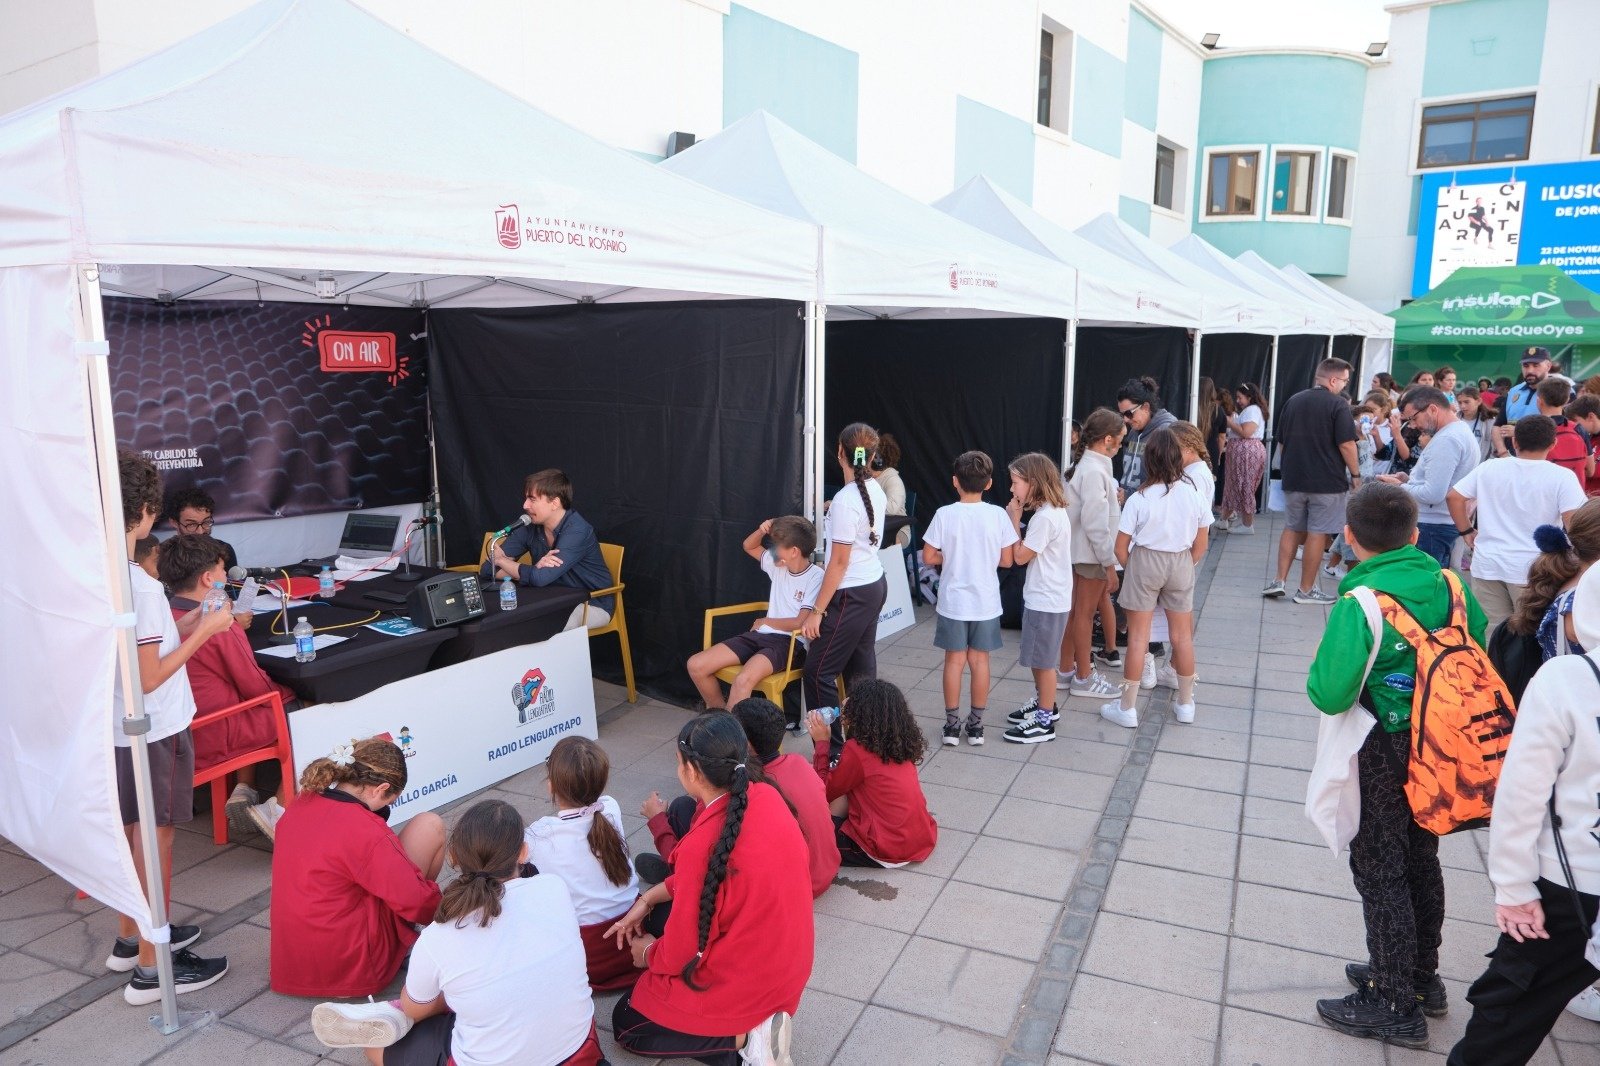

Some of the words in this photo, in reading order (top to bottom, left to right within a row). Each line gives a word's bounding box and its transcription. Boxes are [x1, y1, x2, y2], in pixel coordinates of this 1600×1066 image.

[1555, 207, 1574, 217] DE
[1574, 205, 1600, 218] JOR
[526, 216, 625, 238] AYUNTAMIENTO
[526, 229, 565, 244] PUERTO
[567, 233, 585, 247] DEL
[589, 236, 627, 253] ROSARIO
[1540, 247, 1553, 255] 22
[1553, 246, 1567, 254] DE
[1567, 245, 1600, 254] NOVIE
[1442, 292, 1531, 310] insular
[1431, 325, 1584, 338] #SomosLoQueOyes
[333, 342, 354, 362] ON
[359, 342, 382, 364] AIR
[154, 449, 186, 460] CABILDO
[187, 448, 198, 458] DE
[155, 458, 204, 470] RTEVENTURA
[528, 701, 556, 720] LENGUATRAPO
[488, 741, 518, 761] RADIO
[519, 716, 582, 750] LENGUATRAPO
[391, 790, 420, 810] RILLO
[421, 773, 458, 796] GARCÍA
